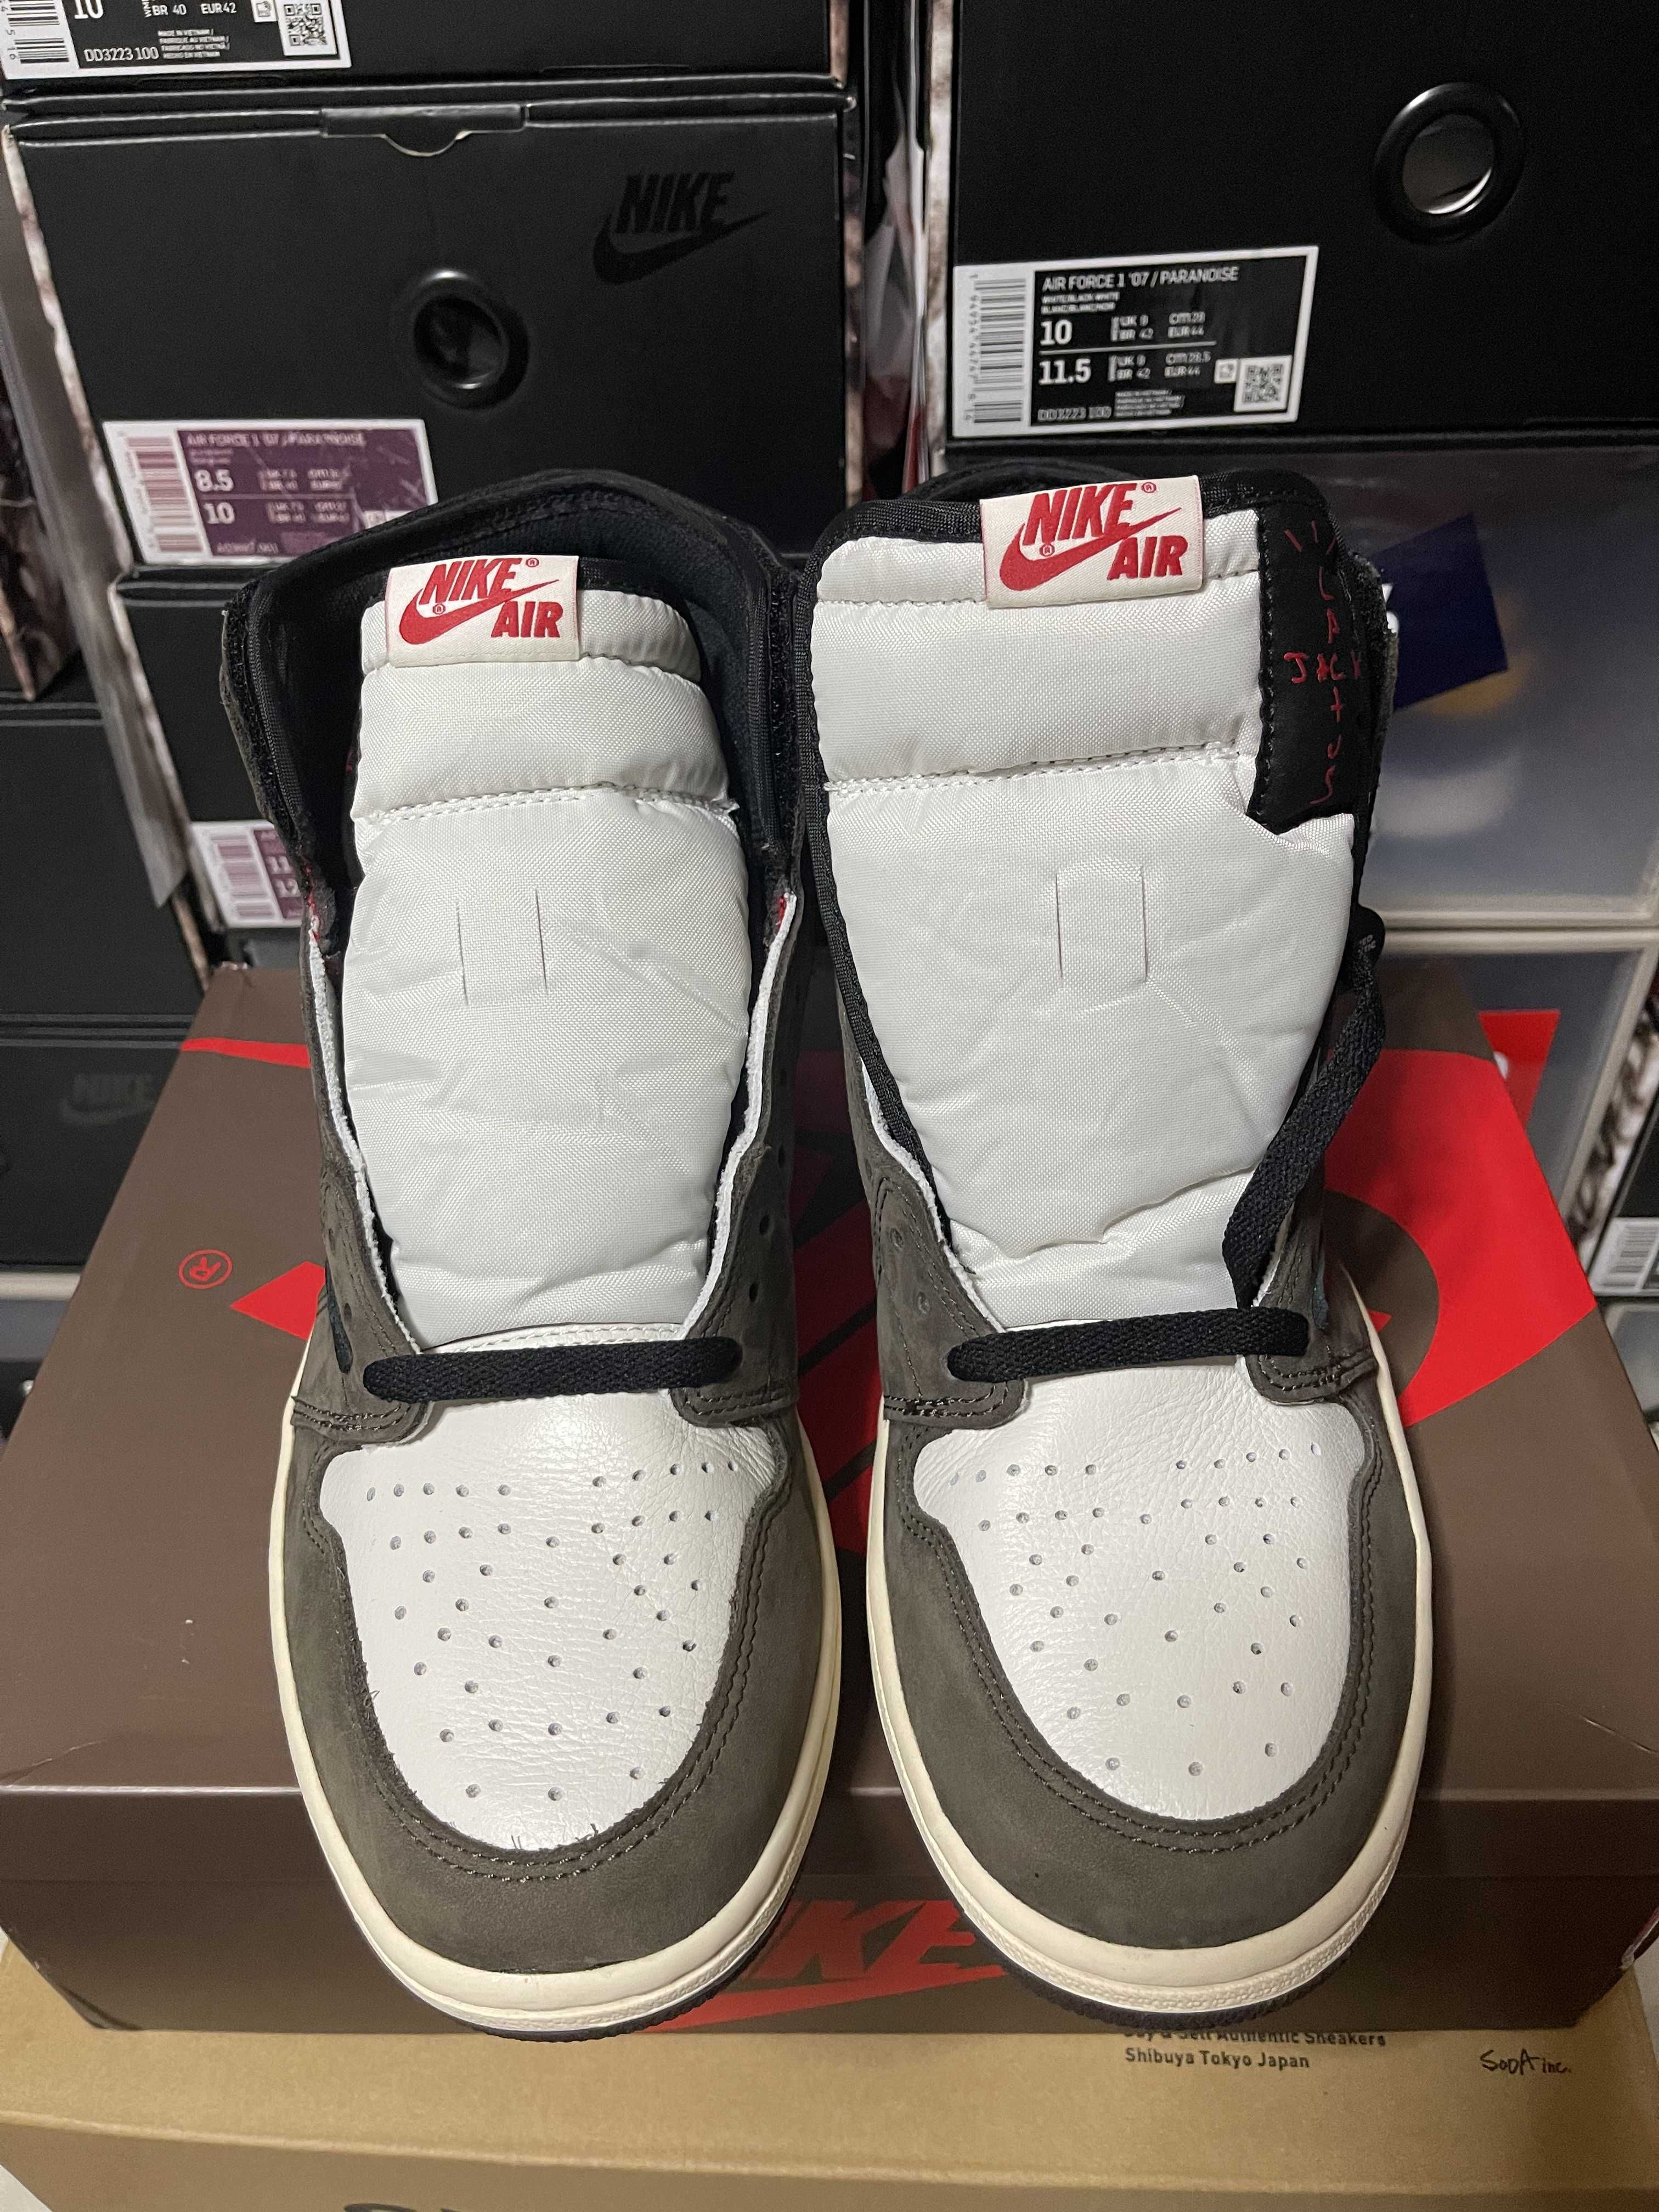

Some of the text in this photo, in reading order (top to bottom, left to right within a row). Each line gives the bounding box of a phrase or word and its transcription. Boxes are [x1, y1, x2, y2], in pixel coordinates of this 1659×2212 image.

[74, 0, 104, 19] 10
[151, 2, 237, 16] BR 40 EUR 42
[84, 46, 160, 62] DD3223 100
[613, 171, 735, 234] NIKE
[1041, 276, 1066, 292] AIR
[1068, 273, 1115, 291] FORCE
[1116, 273, 1126, 288] 1
[1128, 271, 1150, 287] '07
[1159, 266, 1239, 285] PARANOISE
[1040, 319, 1072, 346] 10
[1039, 359, 1091, 385] 11.5
[194, 469, 234, 493] 8.5
[202, 502, 236, 524] 10
[1022, 483, 1137, 546] NIKE
[1107, 535, 1189, 581] AIR
[418, 557, 523, 605] NIKE
[490, 601, 564, 637] AIR
[1125, 2047, 1310, 2072] Shibuya Tokyo Japan
